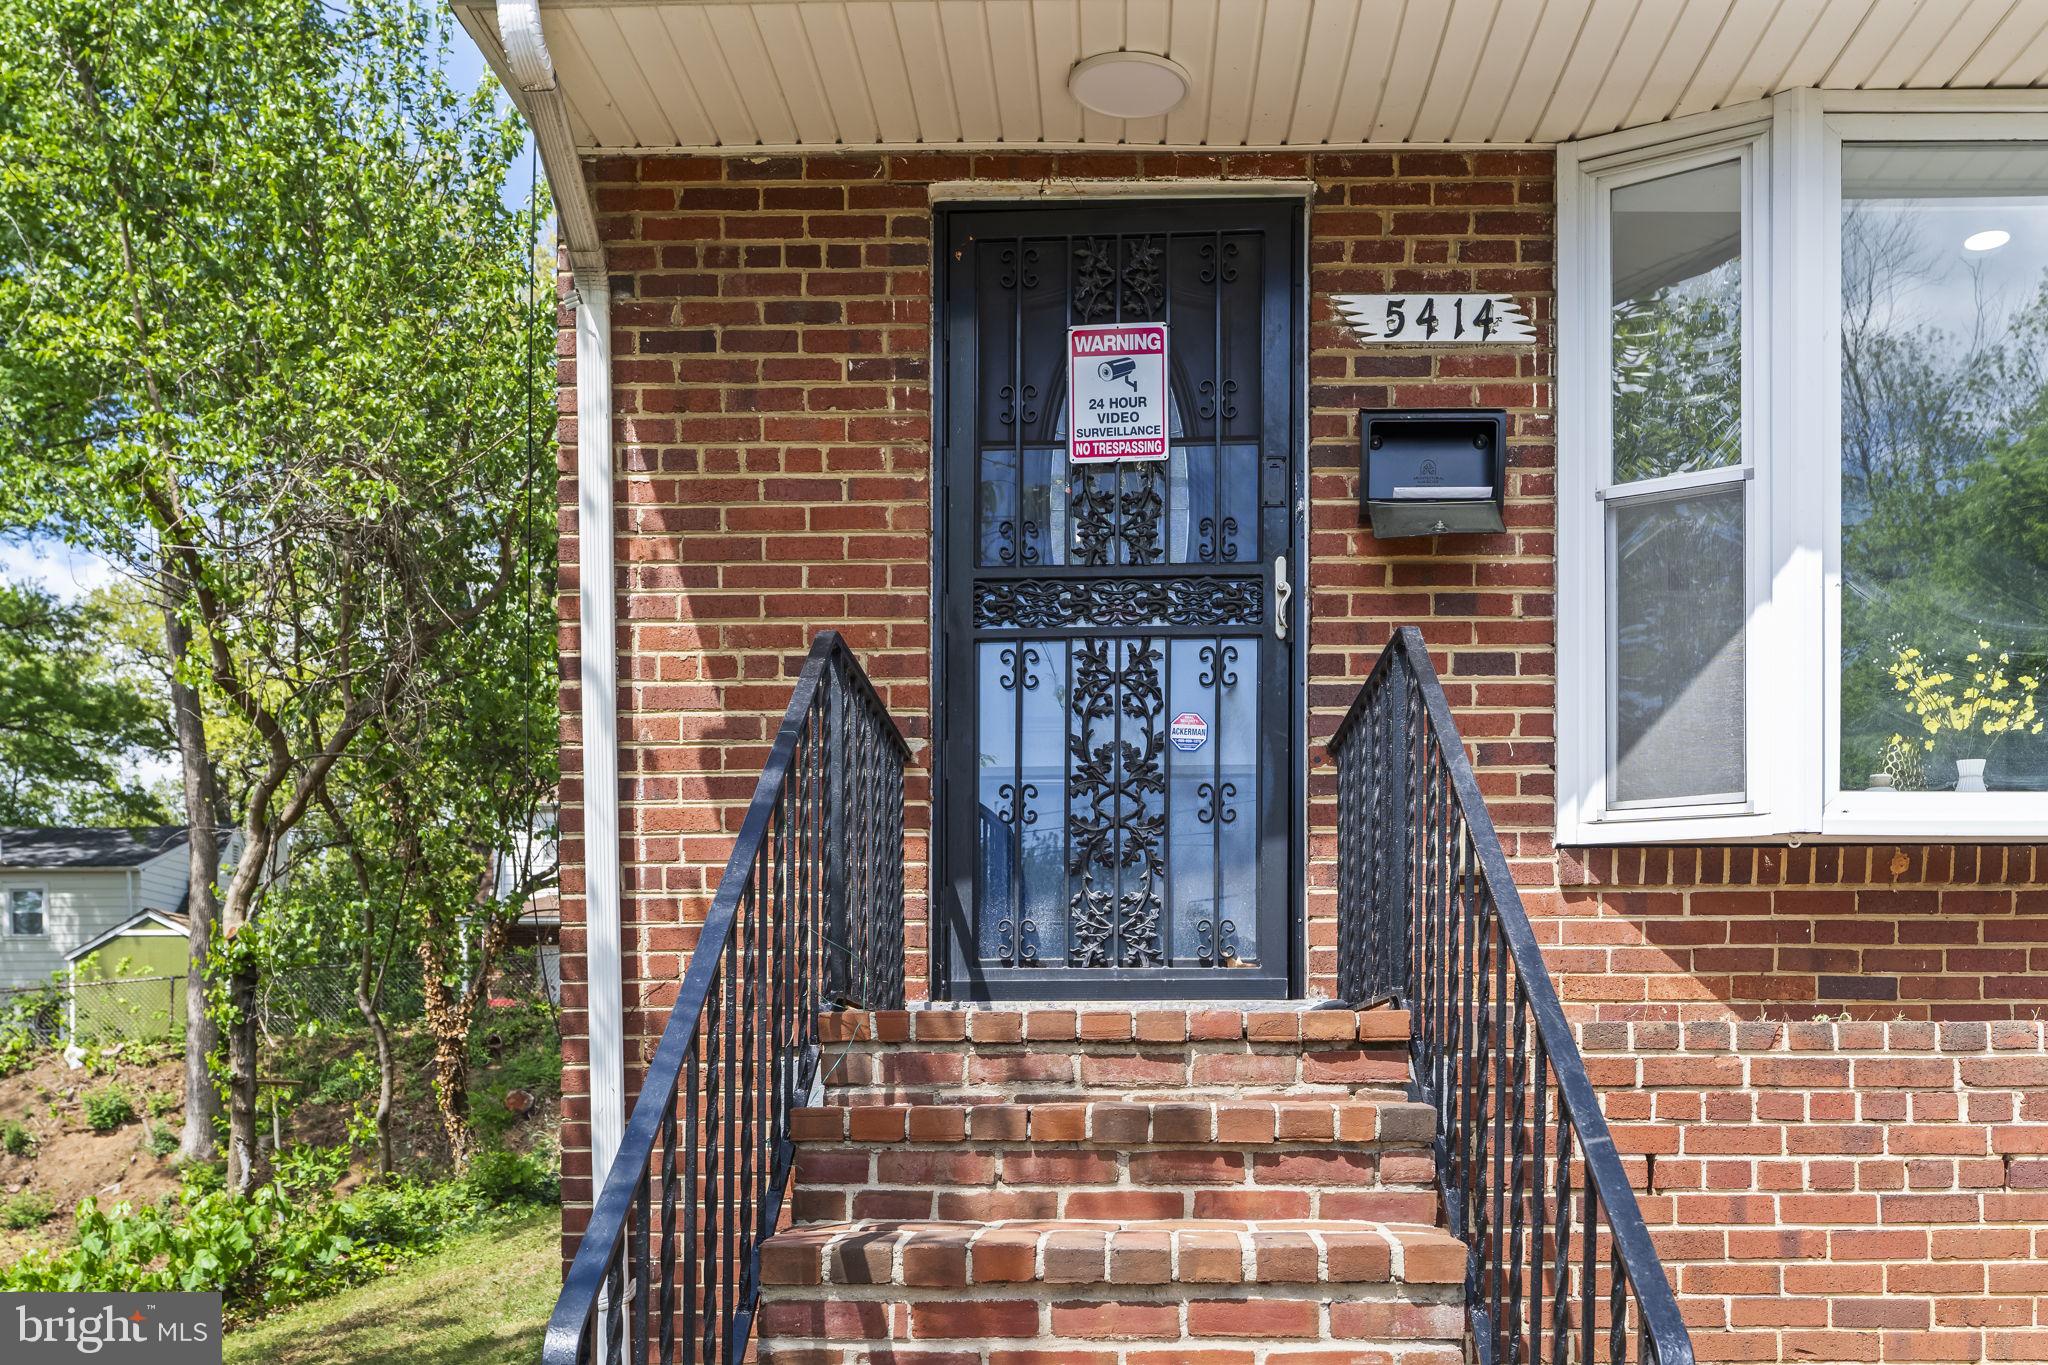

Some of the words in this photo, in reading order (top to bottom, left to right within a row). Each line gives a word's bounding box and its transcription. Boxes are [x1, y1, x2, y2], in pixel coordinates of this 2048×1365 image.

[1384, 298, 1494, 341] 5414
[1074, 333, 1161, 353] WARNING
[1088, 398, 1105, 410] 24
[1109, 396, 1147, 409] HOUR
[1097, 411, 1140, 424] VIDEO
[1076, 425, 1161, 438] SURVEILLANCE
[1075, 443, 1091, 456] NO
[1092, 440, 1162, 455] TRESPASSING
[1171, 727, 1206, 736] ACKERMAN
